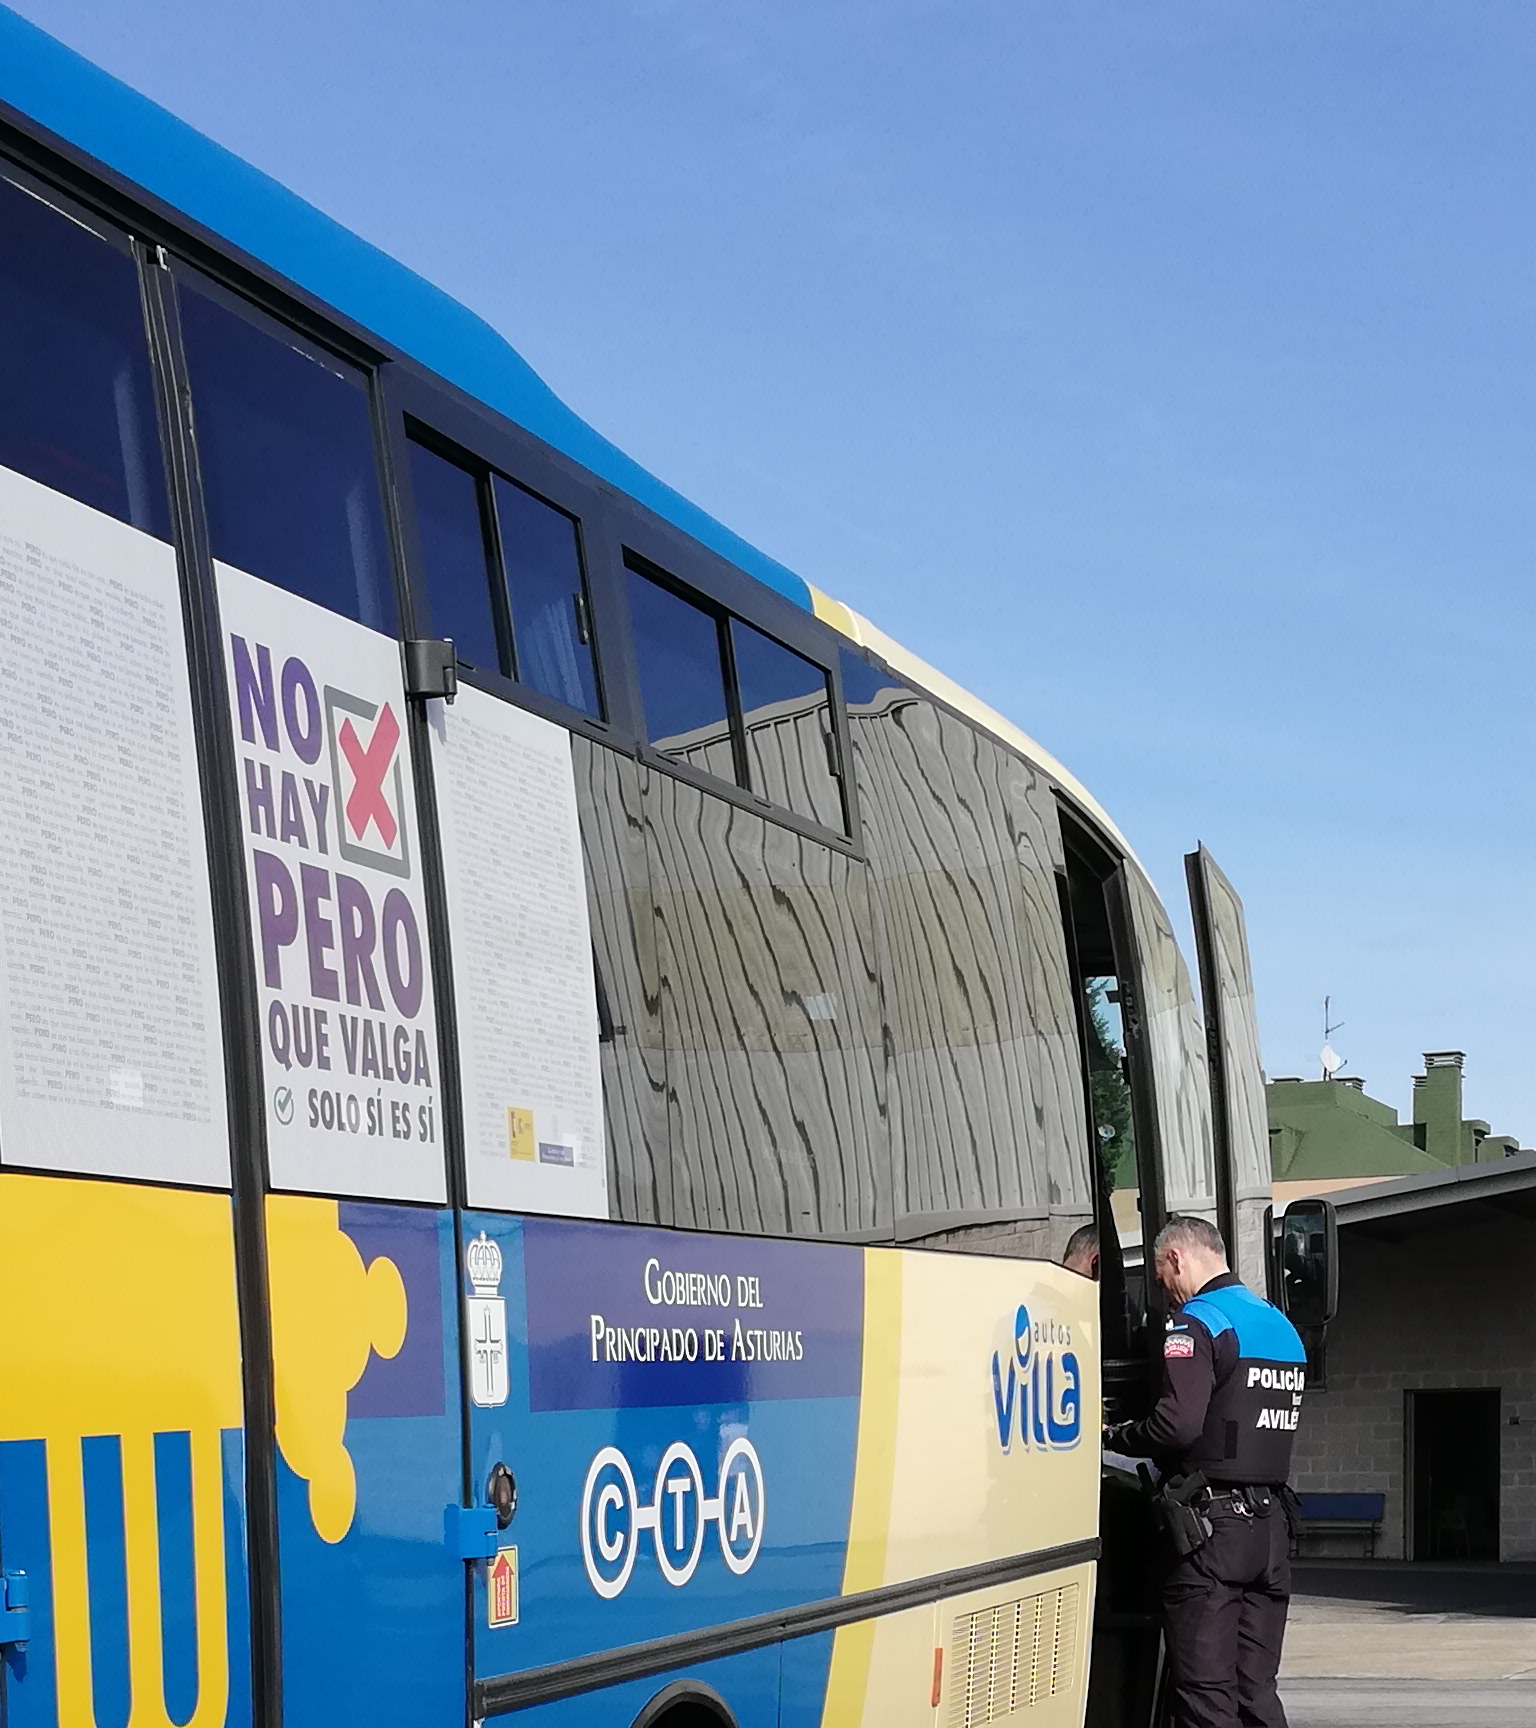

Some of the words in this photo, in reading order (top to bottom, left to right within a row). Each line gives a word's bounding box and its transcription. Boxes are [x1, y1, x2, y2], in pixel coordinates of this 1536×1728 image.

[230, 632, 323, 766] NO
[243, 756, 329, 856] HAY
[252, 848, 423, 1020] PERO
[268, 999, 331, 1072] QUE
[338, 1012, 433, 1088] VALGA
[307, 1087, 361, 1134] SOLO
[366, 1087, 385, 1138] SÍ
[392, 1099, 412, 1140] ES
[418, 1096, 436, 1143] SÍ
[1034, 1319, 1071, 1346] autos
[1247, 1367, 1305, 1392] POLICÍA
[1256, 1407, 1300, 1431] AVILÉ
